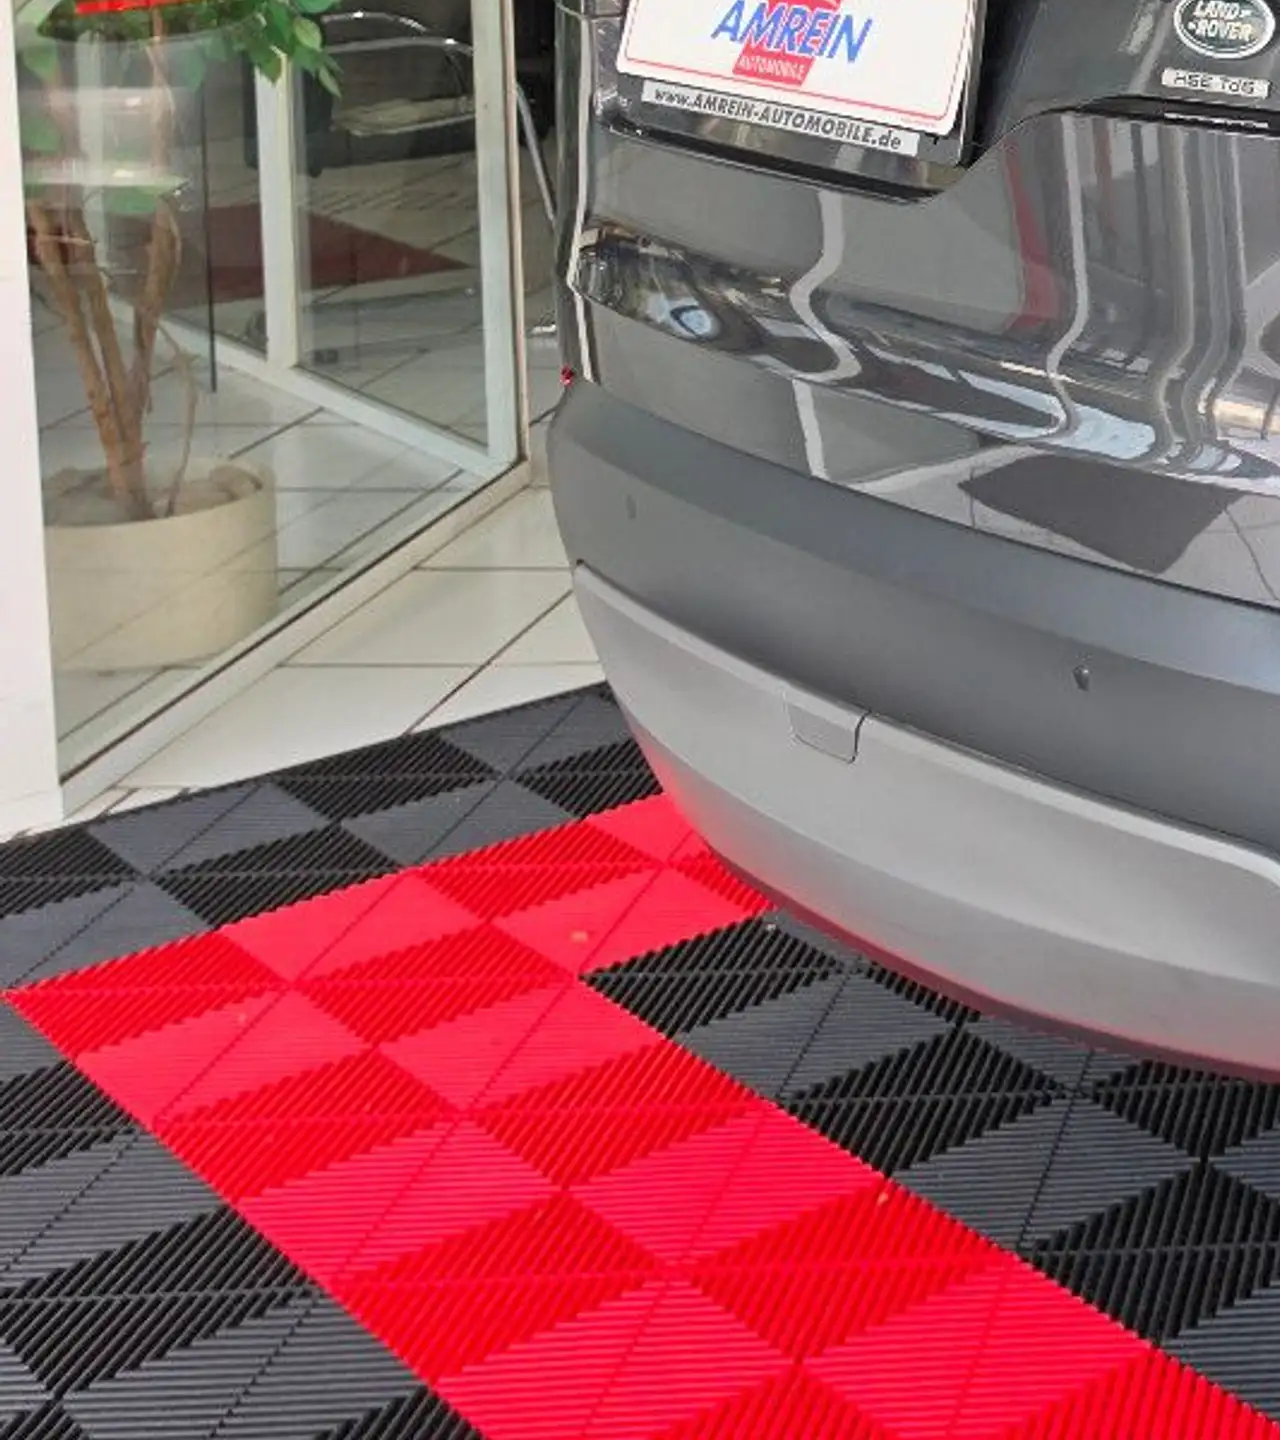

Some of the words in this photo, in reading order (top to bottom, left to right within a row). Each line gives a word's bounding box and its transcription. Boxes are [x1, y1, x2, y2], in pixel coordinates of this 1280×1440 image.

[1192, 0, 1241, 21] LAND
[1195, 19, 1254, 42] ROVER
[737, 55, 807, 81] AUTOMOBILE
[653, 86, 902, 151] www.AMREIN-AUTOMOBILE.de
